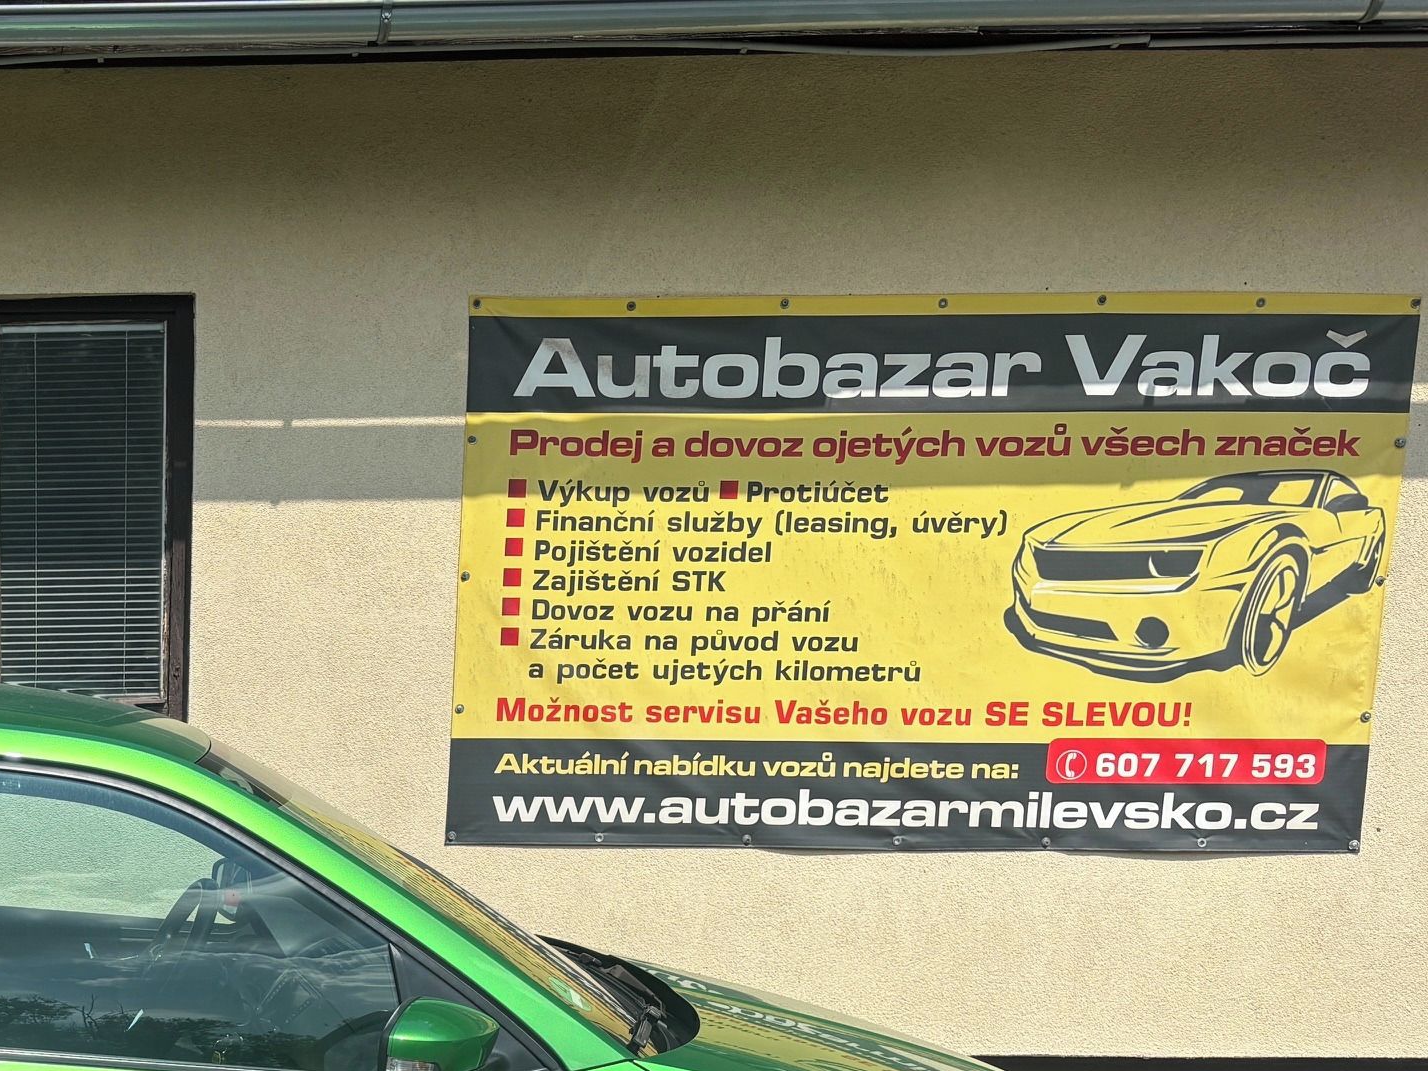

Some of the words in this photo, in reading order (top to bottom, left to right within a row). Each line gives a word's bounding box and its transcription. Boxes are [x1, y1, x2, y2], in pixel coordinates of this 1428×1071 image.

[514, 337, 1041, 399] Autobazar
[1066, 331, 1370, 397] Vakoč
[509, 430, 643, 464] Prodej
[652, 437, 675, 458] a
[685, 432, 803, 458] dovoz
[813, 429, 966, 465] ojetých
[976, 426, 1072, 458] vozů
[1082, 425, 1206, 457] všech
[1215, 425, 1360, 458] značek
[538, 479, 630, 507] Výkup
[643, 481, 709, 502] vozů
[747, 480, 888, 502] Protiúčet
[536, 510, 655, 531] Finanční
[668, 511, 762, 538] služby
[776, 510, 897, 539] (leasing,
[913, 510, 1007, 539] úvěry)
[535, 540, 660, 567] Pojištění
[673, 541, 771, 562] vozidel
[533, 569, 660, 596] Zajištění
[673, 571, 726, 591] STK
[532, 599, 614, 620] Dovoz
[628, 606, 692, 621] vozu
[706, 606, 738, 621] na
[752, 600, 831, 627] přání
[530, 627, 630, 649] Záruka
[645, 635, 677, 650] na
[691, 630, 778, 656] původ
[792, 637, 858, 652] vozu
[529, 664, 543, 678] a
[557, 658, 639, 684] počet
[653, 659, 762, 686] ujetých
[776, 660, 920, 682] kilometrů
[497, 698, 632, 722] Možnost
[646, 705, 760, 724] servisu
[775, 700, 888, 725] Vašeho
[902, 708, 971, 726] vozu
[986, 702, 1028, 726] SE
[1042, 702, 1191, 727] SLEVOU!
[494, 751, 629, 774] Aktuální
[634, 752, 755, 776] nabídku
[763, 752, 836, 777] vozů
[843, 757, 964, 782] najdete
[972, 764, 1018, 779] na:
[1096, 753, 1160, 777] 607
[1175, 754, 1238, 777] 717
[1252, 754, 1315, 778] 593
[493, 789, 1319, 829] www.autobazarmilevsko.cz
